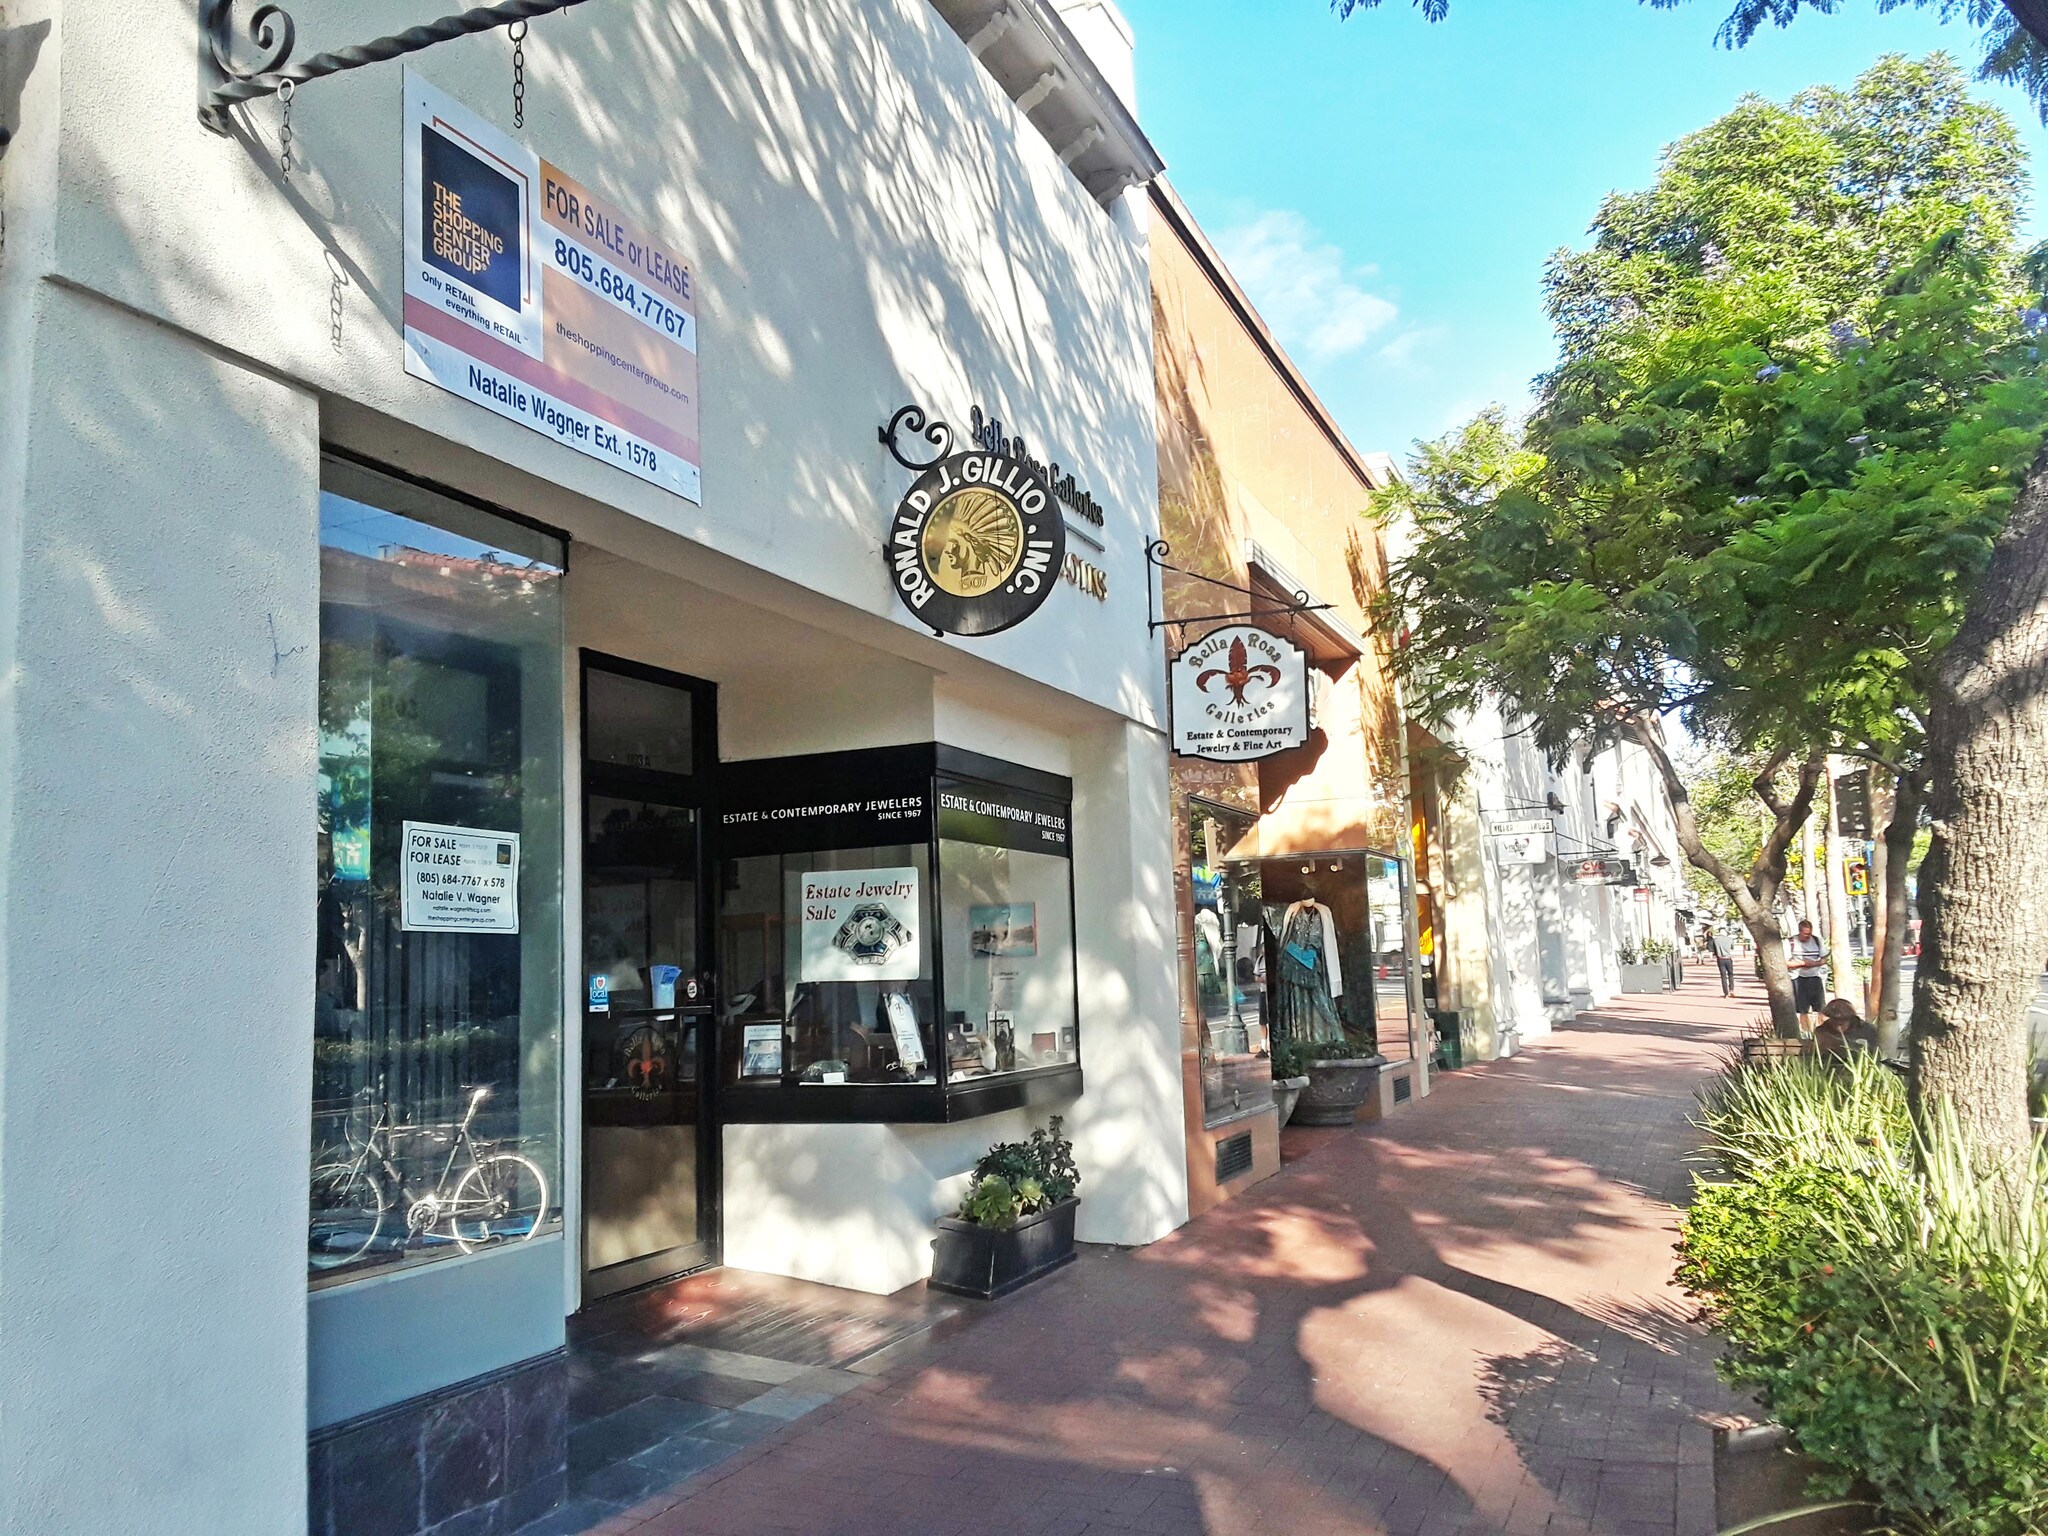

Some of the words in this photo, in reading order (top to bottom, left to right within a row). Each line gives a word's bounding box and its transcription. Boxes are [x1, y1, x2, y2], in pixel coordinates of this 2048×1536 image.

[433, 182, 461, 213] THE
[433, 201, 503, 254] SHOPPING
[546, 179, 580, 228] FOR
[585, 205, 624, 257] SALE
[628, 243, 642, 267] or
[646, 246, 690, 300] LEASE
[433, 221, 490, 265] CENTER
[422, 271, 442, 290] Only
[445, 283, 476, 307] RETAIL
[555, 238, 686, 338] 805.684.7767
[446, 298, 490, 329] everything
[494, 321, 522, 344] RETAIL
[556, 322, 688, 404] theshoppingcentergroup.com
[469, 364, 526, 412] Natalie
[532, 394, 590, 440] Wagner
[594, 425, 621, 456] Ext.
[626, 441, 657, 472] 1578
[1050, 463, 1104, 527] Galleries
[895, 489, 935, 609] RONALD
[1006, 540, 1054, 595] INC.
[1188, 638, 1228, 668] Bella
[1248, 632, 1282, 663] Rosa
[1206, 701, 1275, 724] Galleries
[1187, 731, 1214, 740] Estate
[1216, 730, 1224, 739] &
[1227, 726, 1293, 738] Contemporary
[1196, 744, 1230, 754] Jewelry
[1232, 742, 1241, 751] &
[1243, 741, 1263, 750] Fine
[1266, 740, 1282, 750] Art
[723, 812, 758, 824] ESTATE
[761, 810, 769, 820] &
[770, 802, 862, 820] CONTEMPORARY
[865, 796, 922, 812] JEWELERS
[878, 810, 902, 821] SINCE
[904, 809, 922, 819] 1967
[940, 794, 968, 812] ESTATE
[968, 800, 975, 812] &
[976, 801, 1033, 824] CONTEMPORARY
[1034, 810, 1066, 831] JEWELERS
[411, 835, 432, 848] FOR
[434, 837, 456, 850] SALE
[1041, 830, 1055, 842] SINCE
[1055, 832, 1066, 843] 1967
[410, 852, 430, 864] FOR
[432, 853, 461, 866] LEASE
[1582, 860, 1606, 872] CVS
[416, 872, 440, 886] (805)
[442, 874, 482, 888] 684-7767
[484, 878, 488, 887] x
[491, 878, 506, 888] 578
[805, 884, 852, 900] Estate
[855, 880, 914, 900] Jewelry
[422, 890, 454, 902] Natalie
[456, 892, 466, 902] V.
[466, 894, 500, 906] Wagner
[806, 906, 837, 922] Sale
